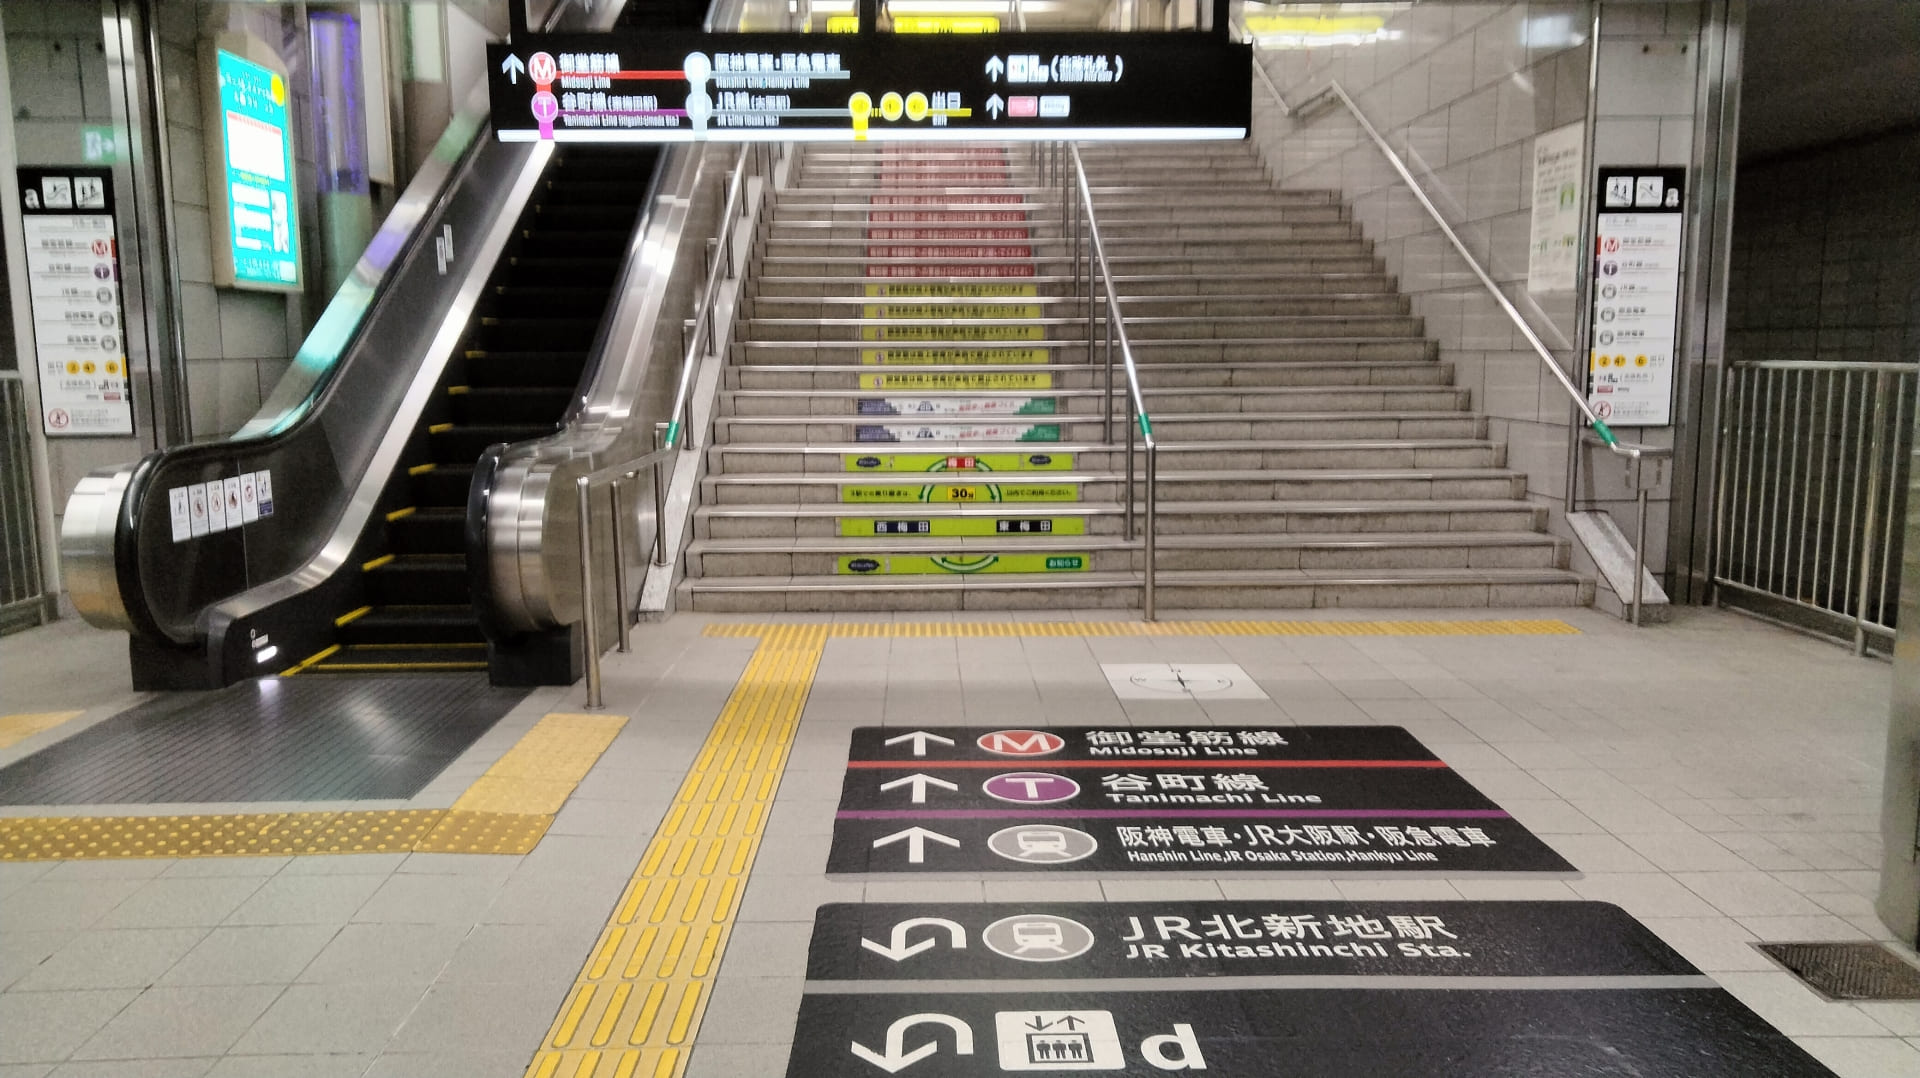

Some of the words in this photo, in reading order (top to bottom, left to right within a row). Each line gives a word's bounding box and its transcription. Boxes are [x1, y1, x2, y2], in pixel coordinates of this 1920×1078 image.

[25, 188, 40, 209] a
[1665, 188, 1680, 207] a
[948, 458, 975, 468] 梅田
[876, 521, 929, 532] 西梅田
[999, 520, 1051, 532] 東梅田
[1049, 558, 1079, 568] お知らせ
[994, 733, 1052, 752] M
[1085, 731, 1289, 746] 御堂筋線
[1089, 746, 1197, 757] Midosuji
[1204, 746, 1258, 756] Line
[1005, 778, 1054, 799] T
[1101, 773, 1270, 792] 谷町線
[1105, 793, 1254, 804] Tanimachi
[1261, 793, 1323, 804] Line
[1128, 850, 1188, 863] Hanshin
[1245, 850, 1291, 863] Osaka
[1403, 850, 1440, 862] Line
[1122, 913, 1459, 942] JR北新地駅
[1126, 943, 1169, 960] JR
[1181, 942, 1389, 959] Kitashinchi
[1397, 942, 1472, 958] Sta.
[1140, 1023, 1207, 1071] d
